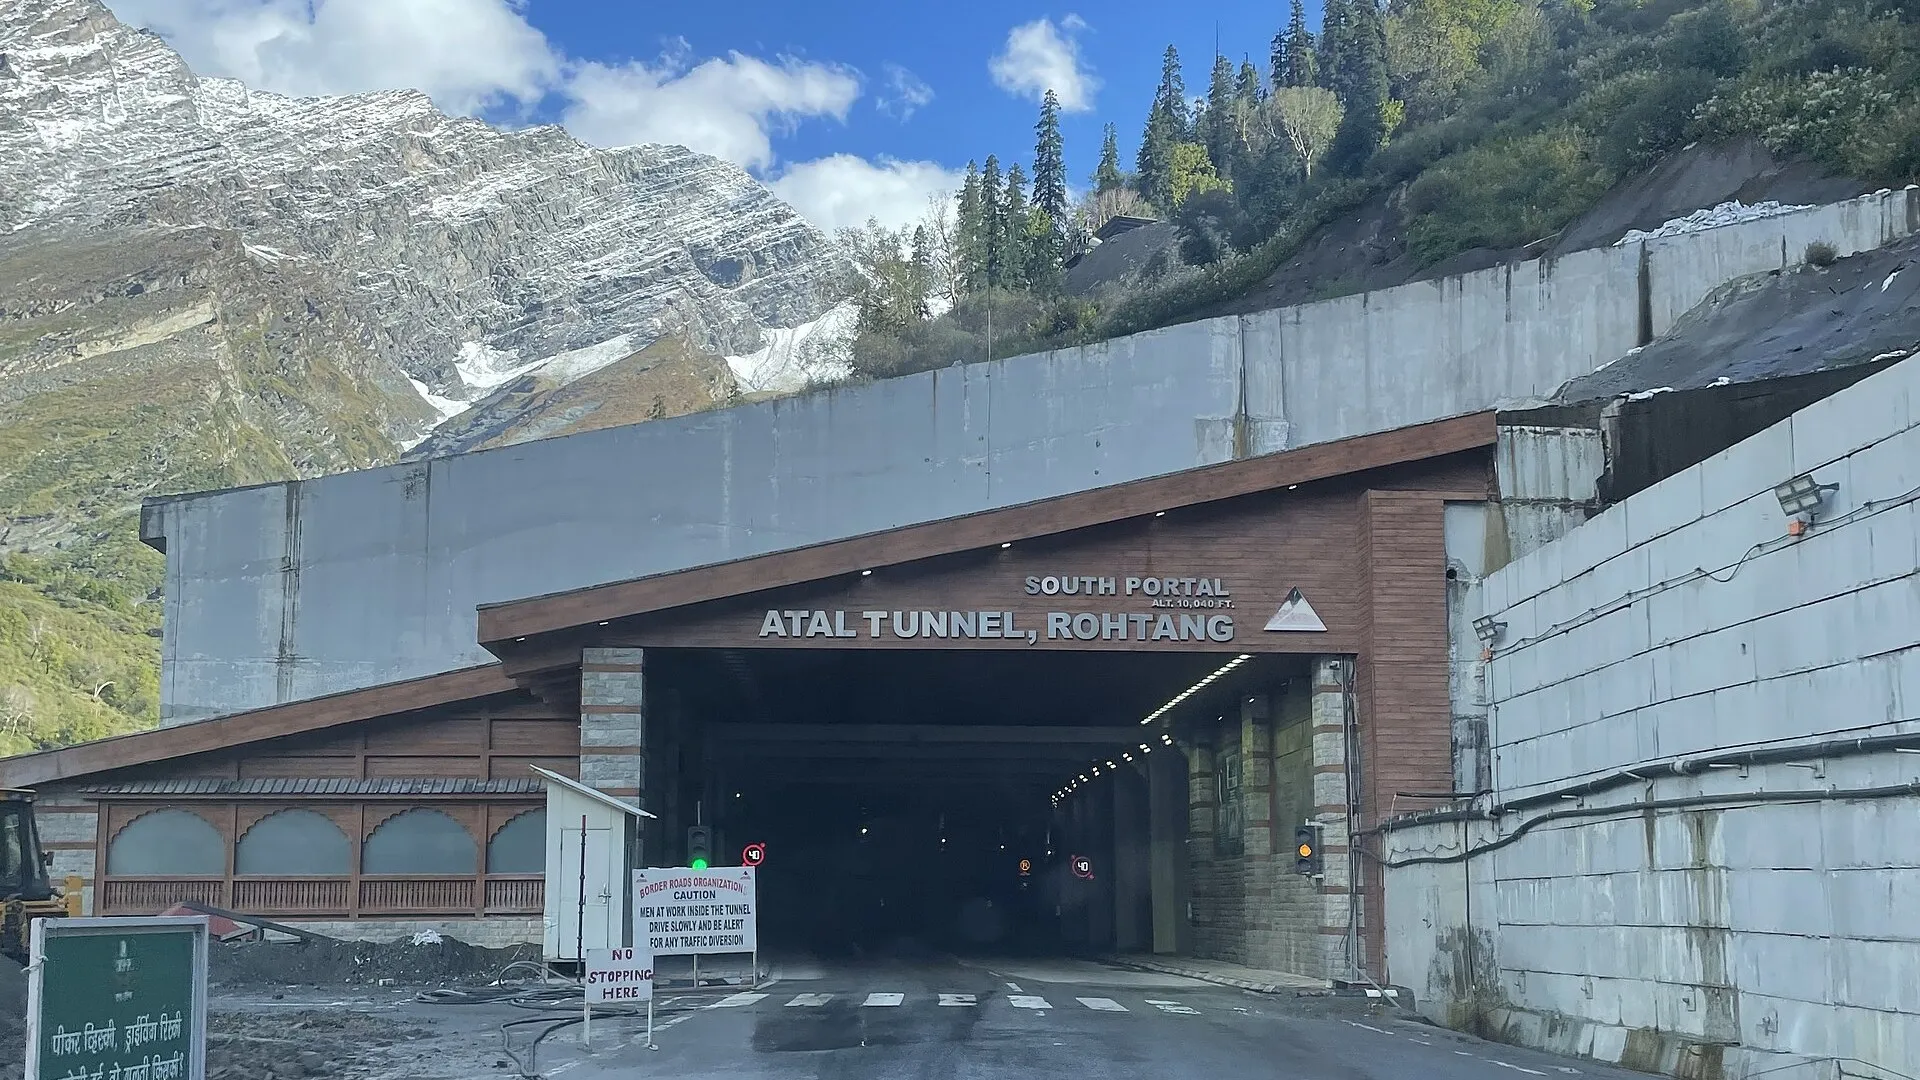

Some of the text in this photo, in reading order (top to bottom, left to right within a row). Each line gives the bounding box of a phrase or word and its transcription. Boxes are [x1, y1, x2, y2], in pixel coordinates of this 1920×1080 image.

[1024, 576, 1230, 596] SOUTH PORTAL
[1152, 599, 1236, 609] ALT. 10,040 FT.
[759, 610, 1235, 645] ATAL TUNNEL, ROHTANG
[748, 850, 760, 860] 40
[1077, 861, 1089, 872] 40
[640, 881, 668, 899] BORDER
[669, 878, 692, 889] ROADS
[673, 890, 716, 900] CAUTION
[640, 904, 751, 918] MEN AT WORK INSIDE THE TUNNEL
[649, 919, 744, 933] DRIVE SLOWLY AND BE ALERT
[650, 934, 744, 949] FOR ANY TRAFFIC DIVERSION
[612, 949, 633, 960] NO
[588, 969, 656, 984] STOPPING
[603, 987, 639, 999] HERE
[52, 1024, 81, 1056] पीकर
